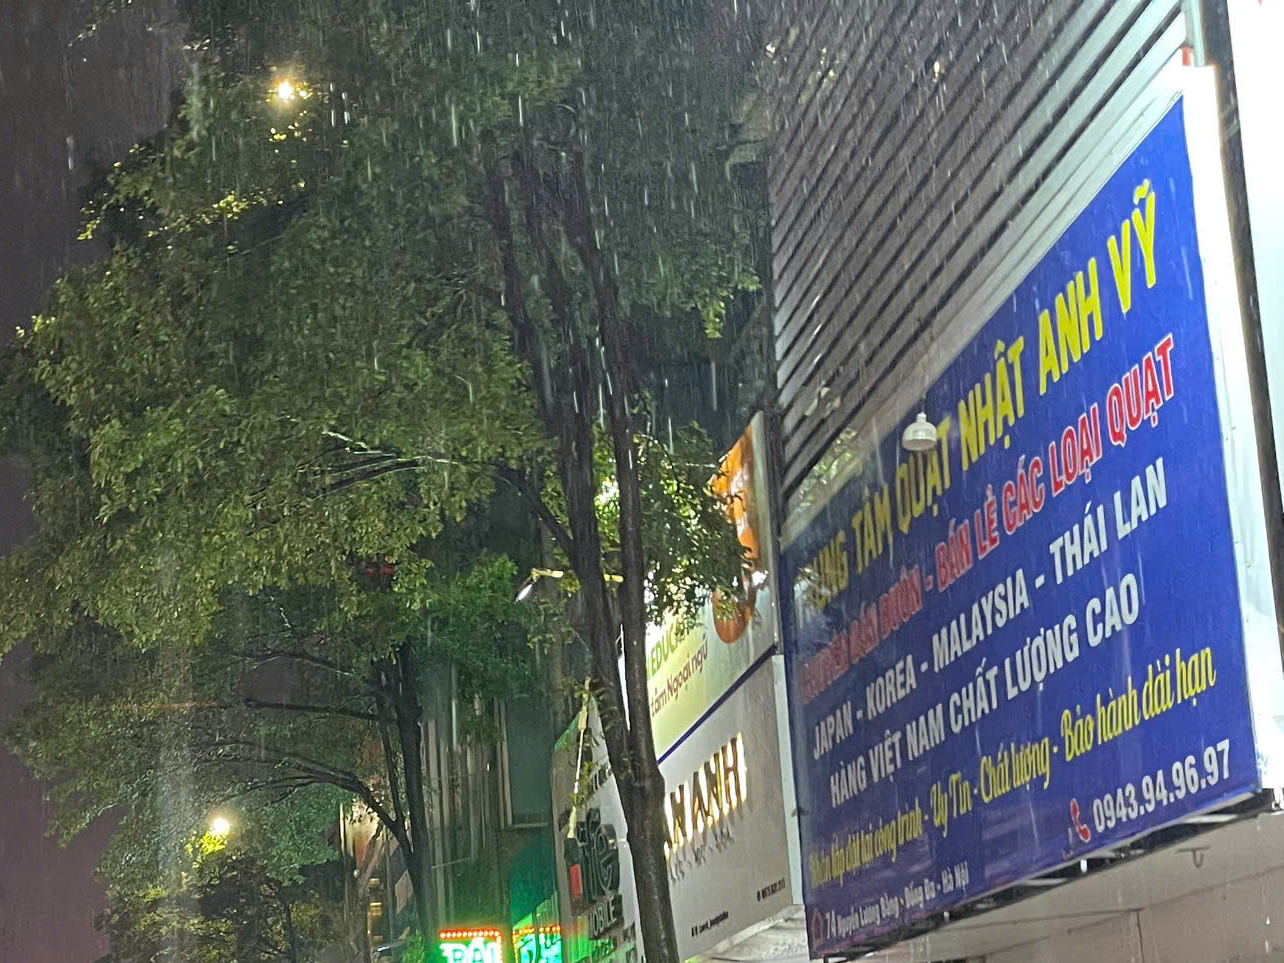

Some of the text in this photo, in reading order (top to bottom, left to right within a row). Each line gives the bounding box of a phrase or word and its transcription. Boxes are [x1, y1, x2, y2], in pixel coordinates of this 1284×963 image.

[895, 421, 952, 535] QUẠT
[958, 337, 1025, 471] NHẬT
[1038, 257, 1103, 395] ANH
[1107, 179, 1157, 315] VỸ
[935, 517, 973, 592] BÁN
[974, 483, 1000, 560] LẺ
[1002, 454, 1045, 535] CÁC
[1049, 402, 1103, 498] LOẠI
[1107, 333, 1175, 448] QUẠT
[813, 457, 1168, 760] JAPAN KOREA MALAYSIA THÁI LAN
[830, 573, 1139, 808] HÀNG VIỆT NAM CHẤT LƯỢNG CAO
[1061, 705, 1094, 761] Bảo
[1096, 675, 1140, 745] hành
[1142, 654, 1174, 720] dài
[1175, 646, 1216, 707] hạn
[1092, 739, 1230, 833] 0943.94.96.97
